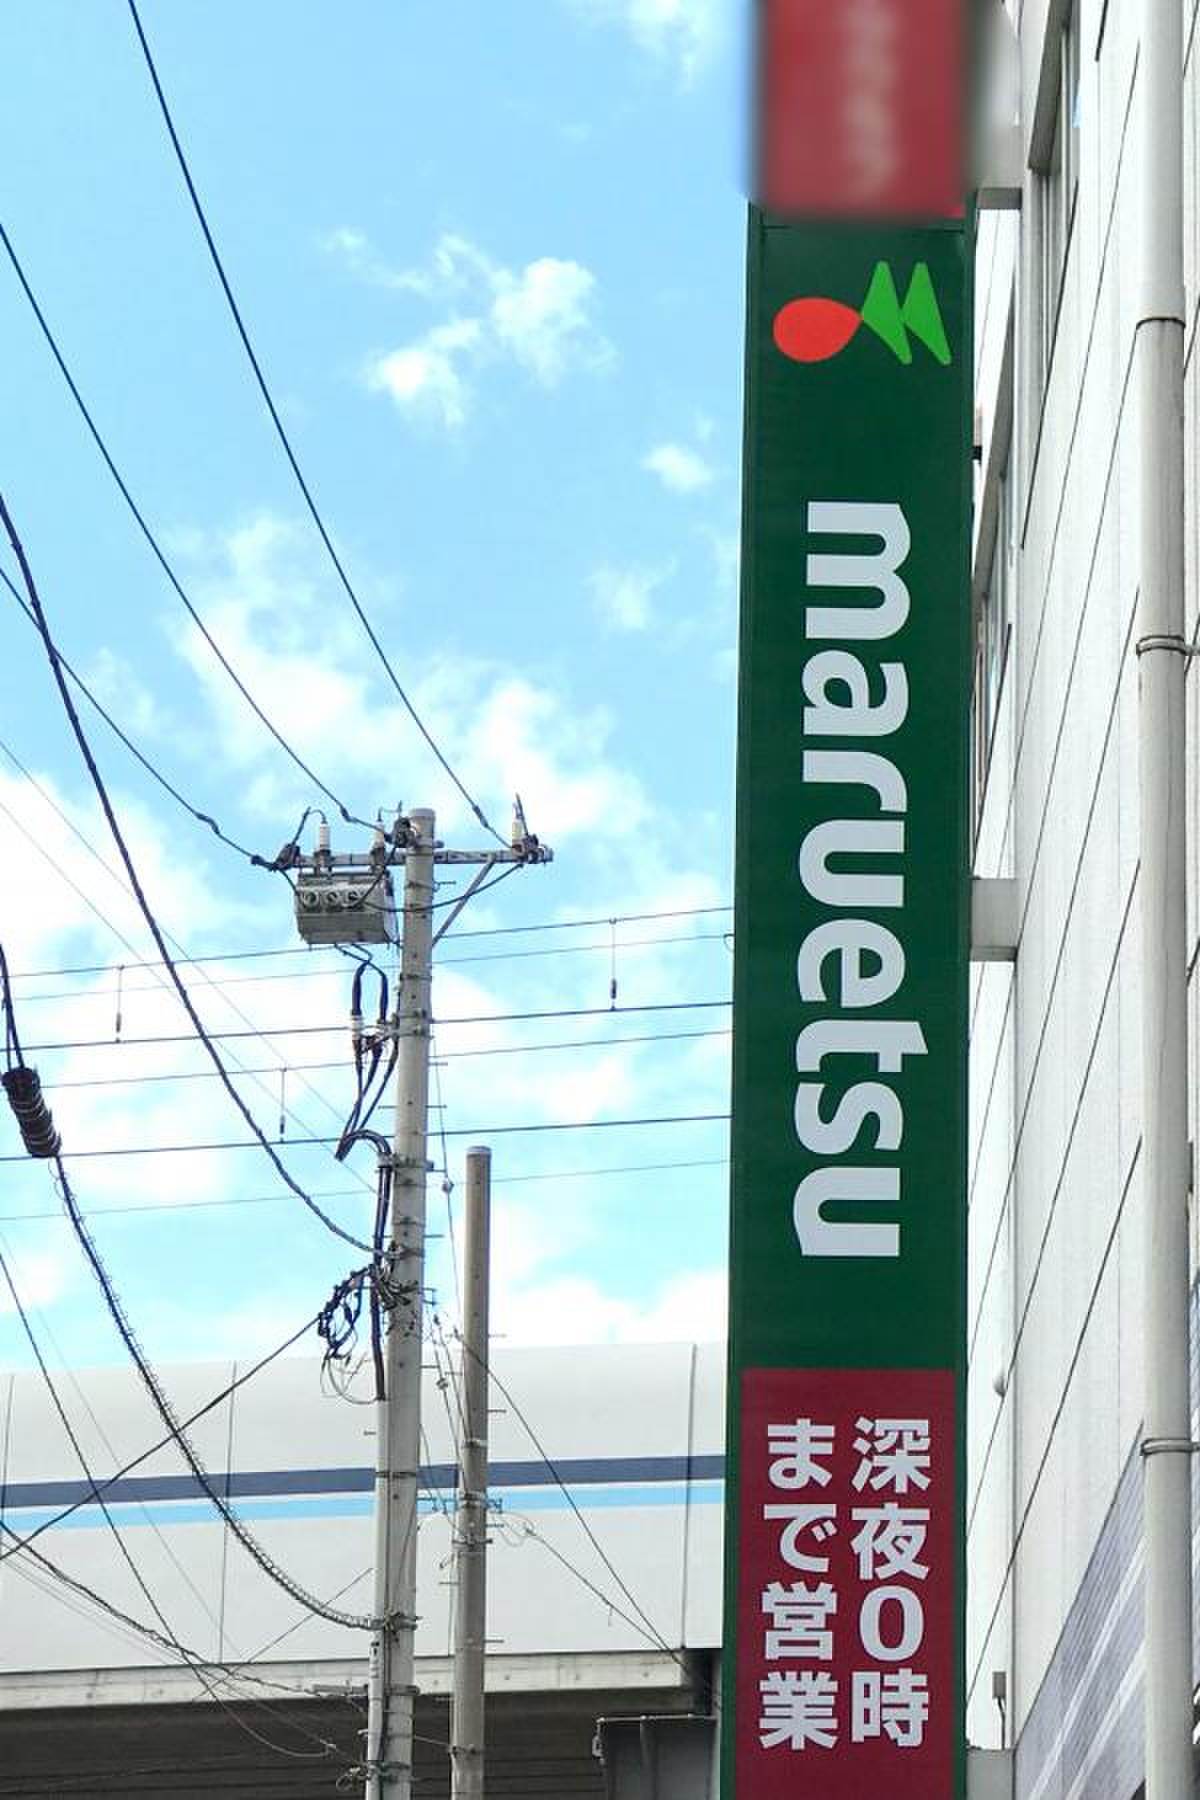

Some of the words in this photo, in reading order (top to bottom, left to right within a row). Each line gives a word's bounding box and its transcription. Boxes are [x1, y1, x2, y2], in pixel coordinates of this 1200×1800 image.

[793, 501, 929, 1257] maruetsu
[759, 1418, 839, 1750] まで営業
[850, 1416, 931, 1747] 深夜0時
